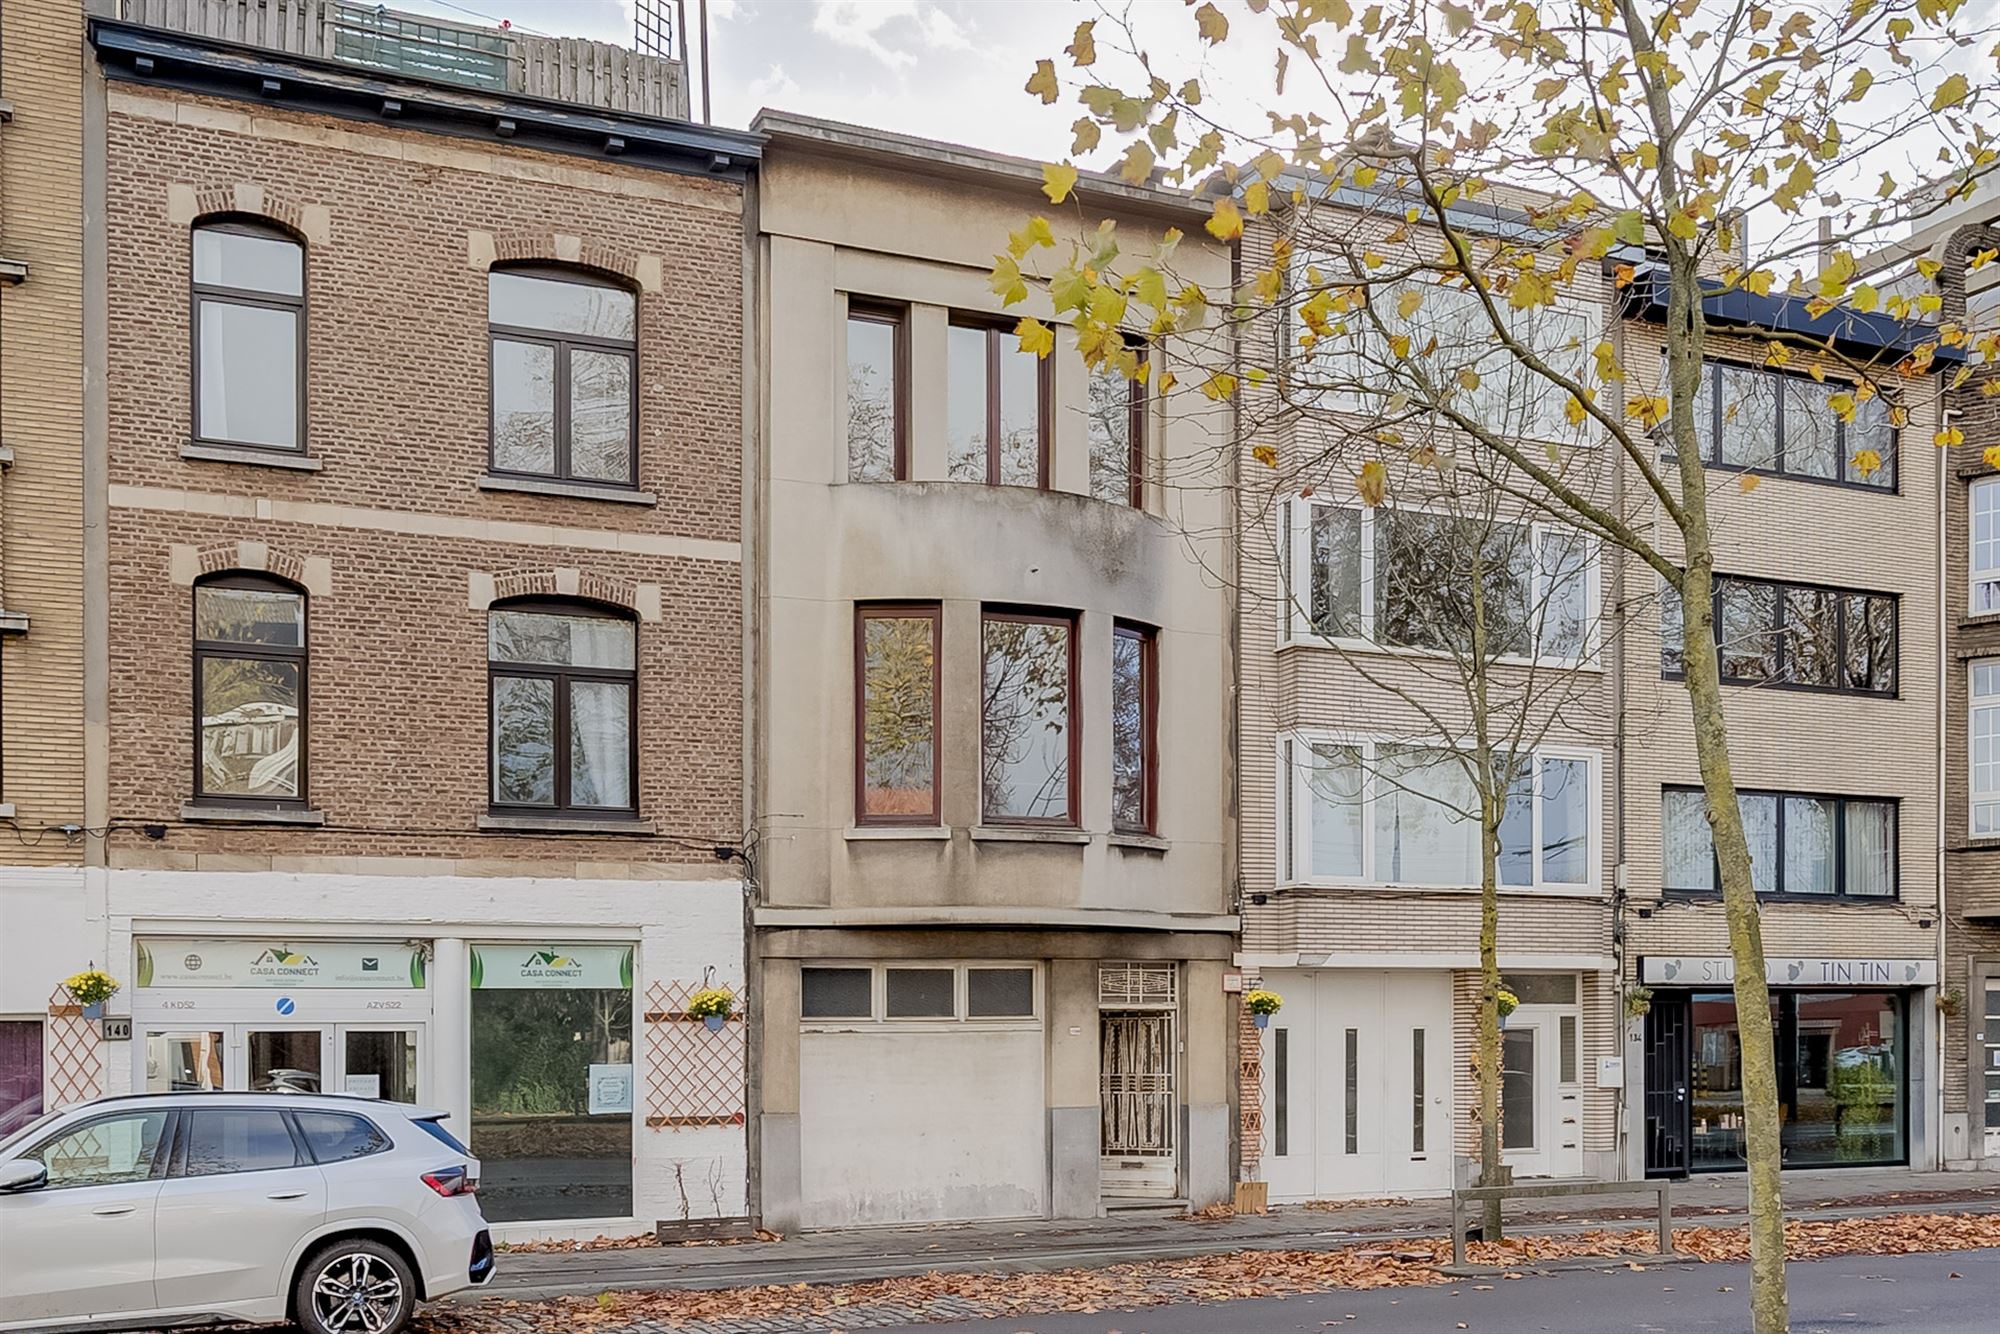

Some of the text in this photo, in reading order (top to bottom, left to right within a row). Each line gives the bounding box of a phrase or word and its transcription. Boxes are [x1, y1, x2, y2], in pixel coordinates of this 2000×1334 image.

[250, 968, 320, 976] CASA CONNECT
[520, 969, 582, 977] CASA CONNECT
[1820, 962, 1851, 981] TIN
[1859, 962, 1890, 982] TIN
[106, 1024, 129, 1037] 140
